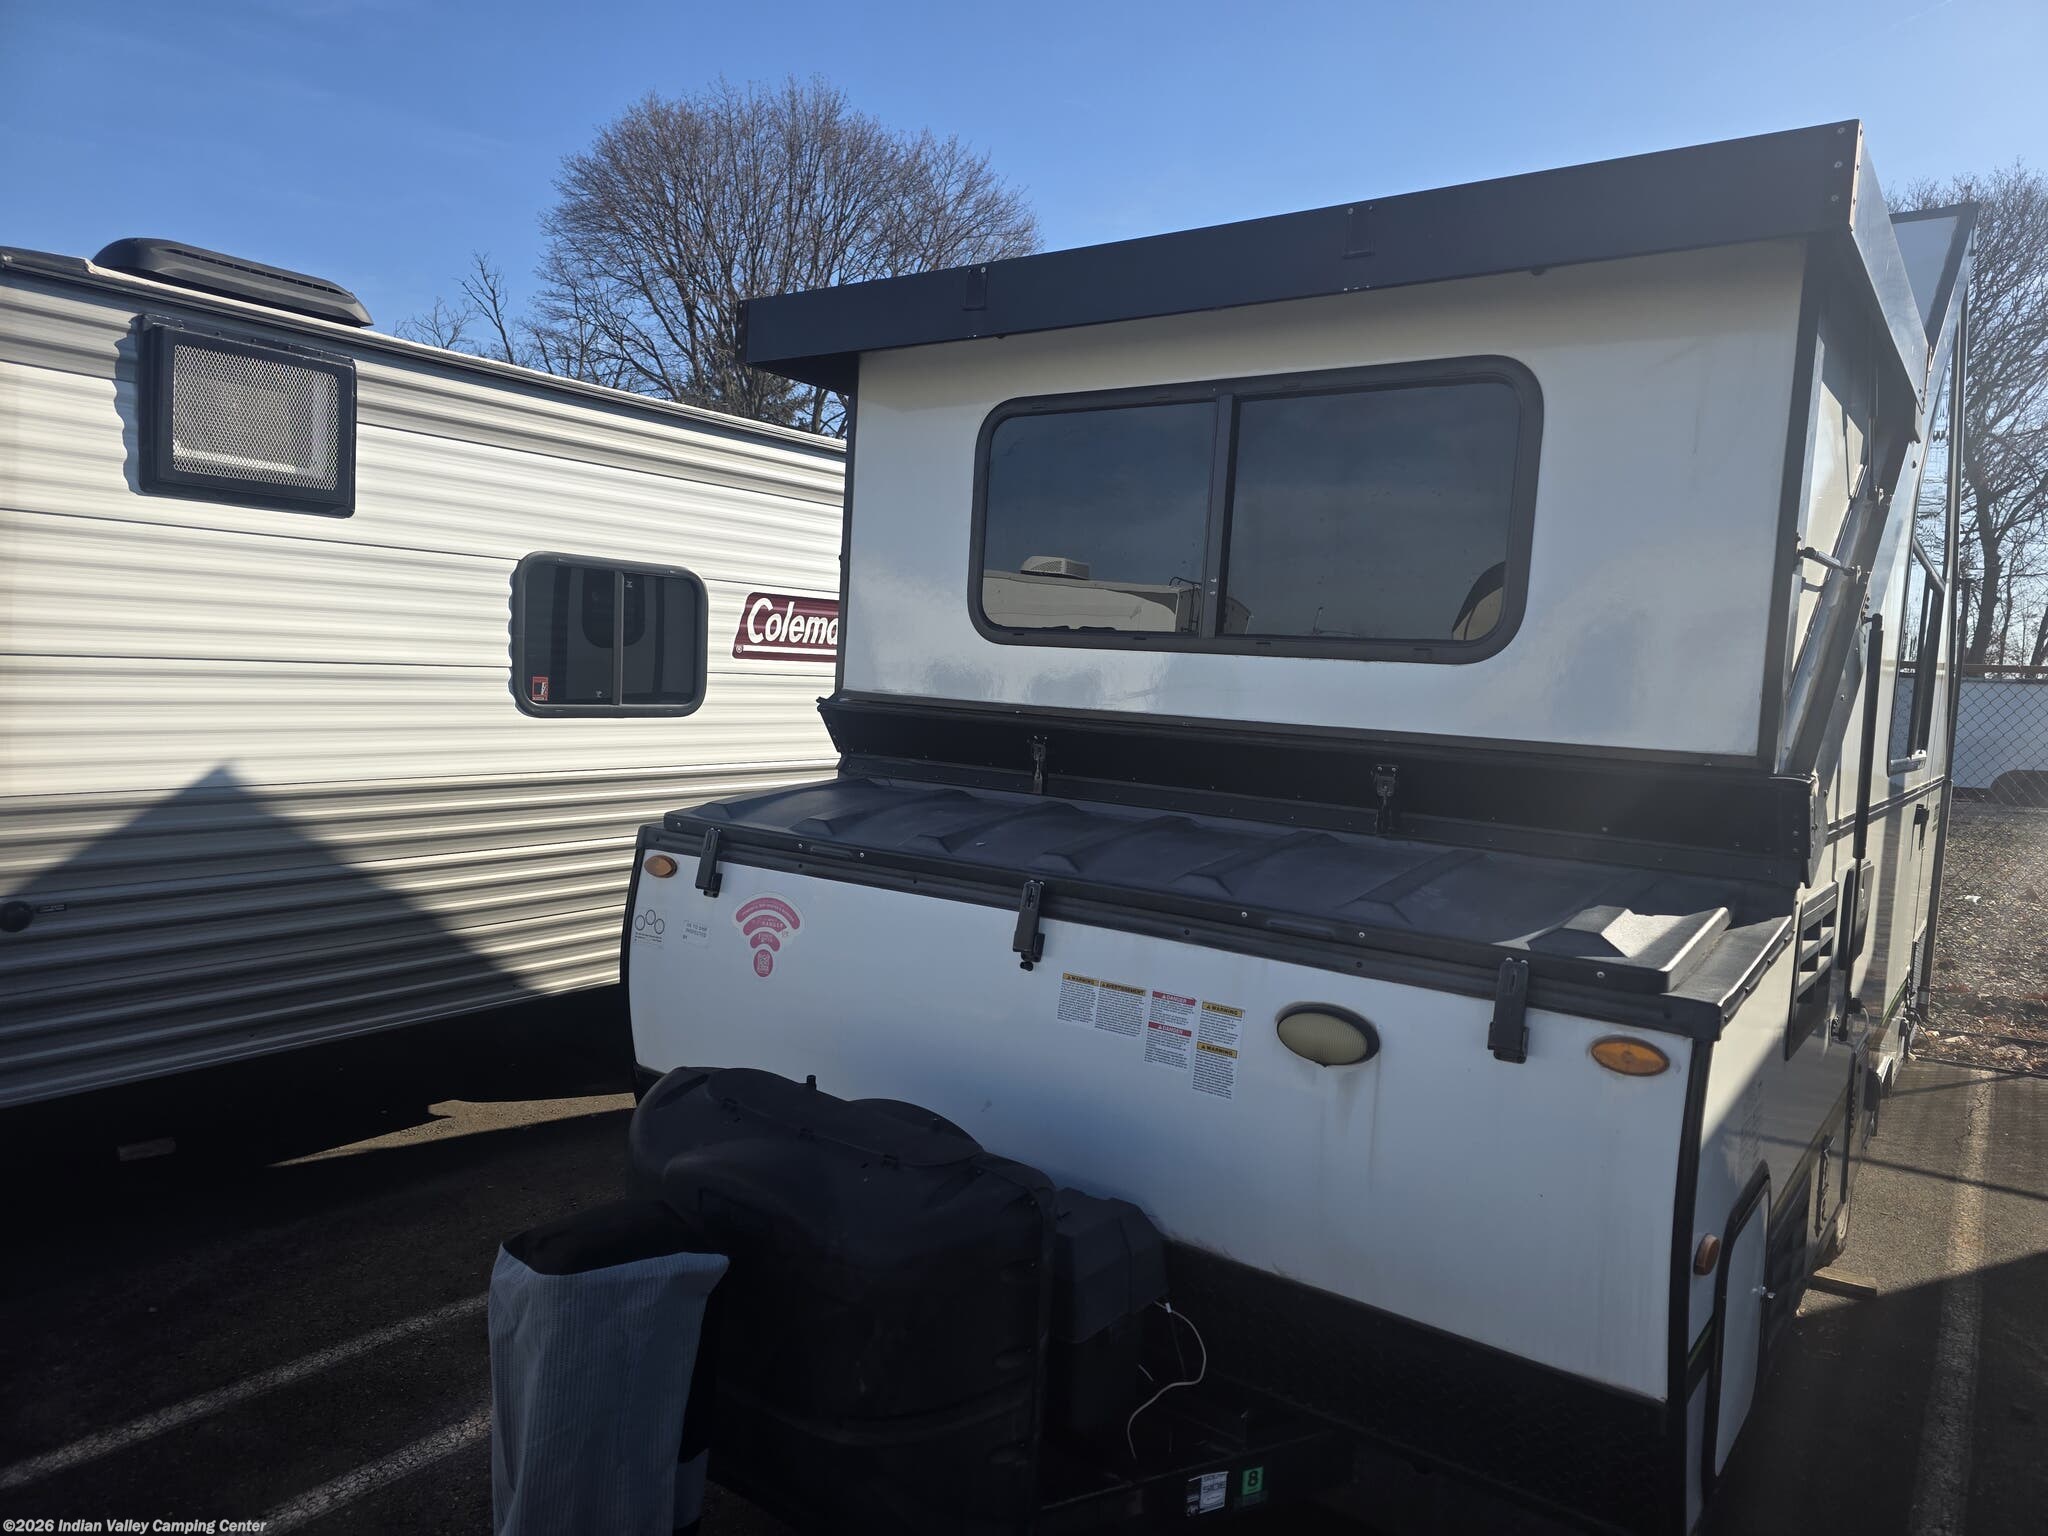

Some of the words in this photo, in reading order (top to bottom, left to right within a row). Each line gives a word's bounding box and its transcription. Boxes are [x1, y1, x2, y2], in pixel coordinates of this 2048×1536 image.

[1166, 994, 1187, 1004] DANGER
[1212, 1004, 1238, 1015] WARNING
[1207, 1045, 1233, 1056] WARNING
[1248, 1470, 1258, 1487] 8
